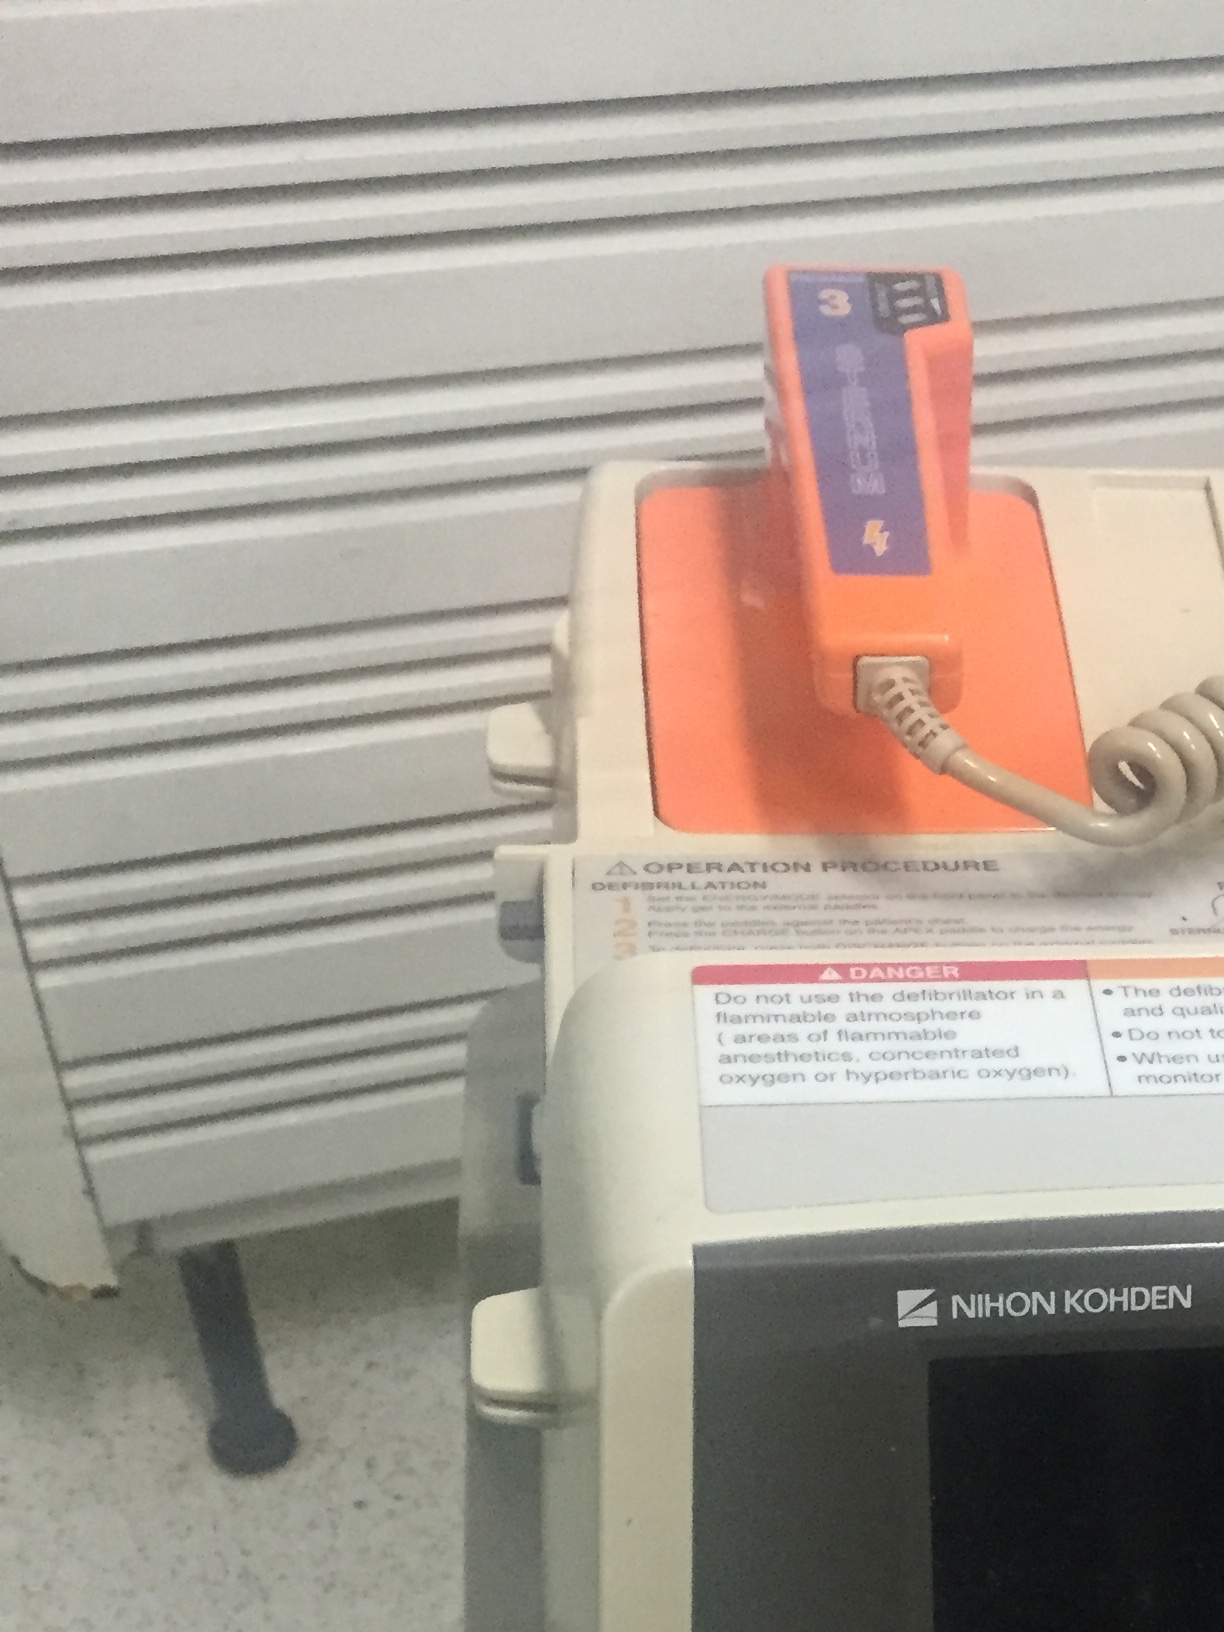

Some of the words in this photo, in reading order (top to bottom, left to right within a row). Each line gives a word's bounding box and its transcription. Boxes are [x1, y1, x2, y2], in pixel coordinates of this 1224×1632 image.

[818, 288, 852, 317] 3
[642, 861, 812, 874] OPERATION
[821, 859, 1000, 873] PROCEDURE
[591, 881, 768, 891] DEFIBRILLATION
[849, 965, 960, 981] DANGER
[714, 991, 749, 1005] Do
[755, 991, 792, 1005] not
[799, 992, 841, 1005] use
[848, 989, 884, 1003] the
[892, 987, 1017, 1003] defibrillator
[1025, 986, 1044, 1000] in
[1050, 988, 1065, 1000] a
[1119, 985, 1161, 998] The
[715, 1009, 837, 1025] flammable
[845, 1007, 982, 1026] atmosphere
[1123, 1004, 1164, 1018] and
[733, 1033, 799, 1045] areas
[807, 1029, 831, 1044] of
[837, 1027, 959, 1043] flammable
[1128, 1027, 1160, 1041] Do
[1167, 1027, 1203, 1041] not
[868, 1044, 1021, 1061] concentrated
[1131, 1051, 1199, 1065] When
[719, 1070, 806, 1087] oxygen
[815, 1070, 838, 1083] or
[845, 1066, 970, 1086] hyperbaric
[1138, 1071, 1222, 1085] monitor
[951, 1291, 1056, 1319] NIHON
[1064, 1283, 1192, 1315] KOHDEN
